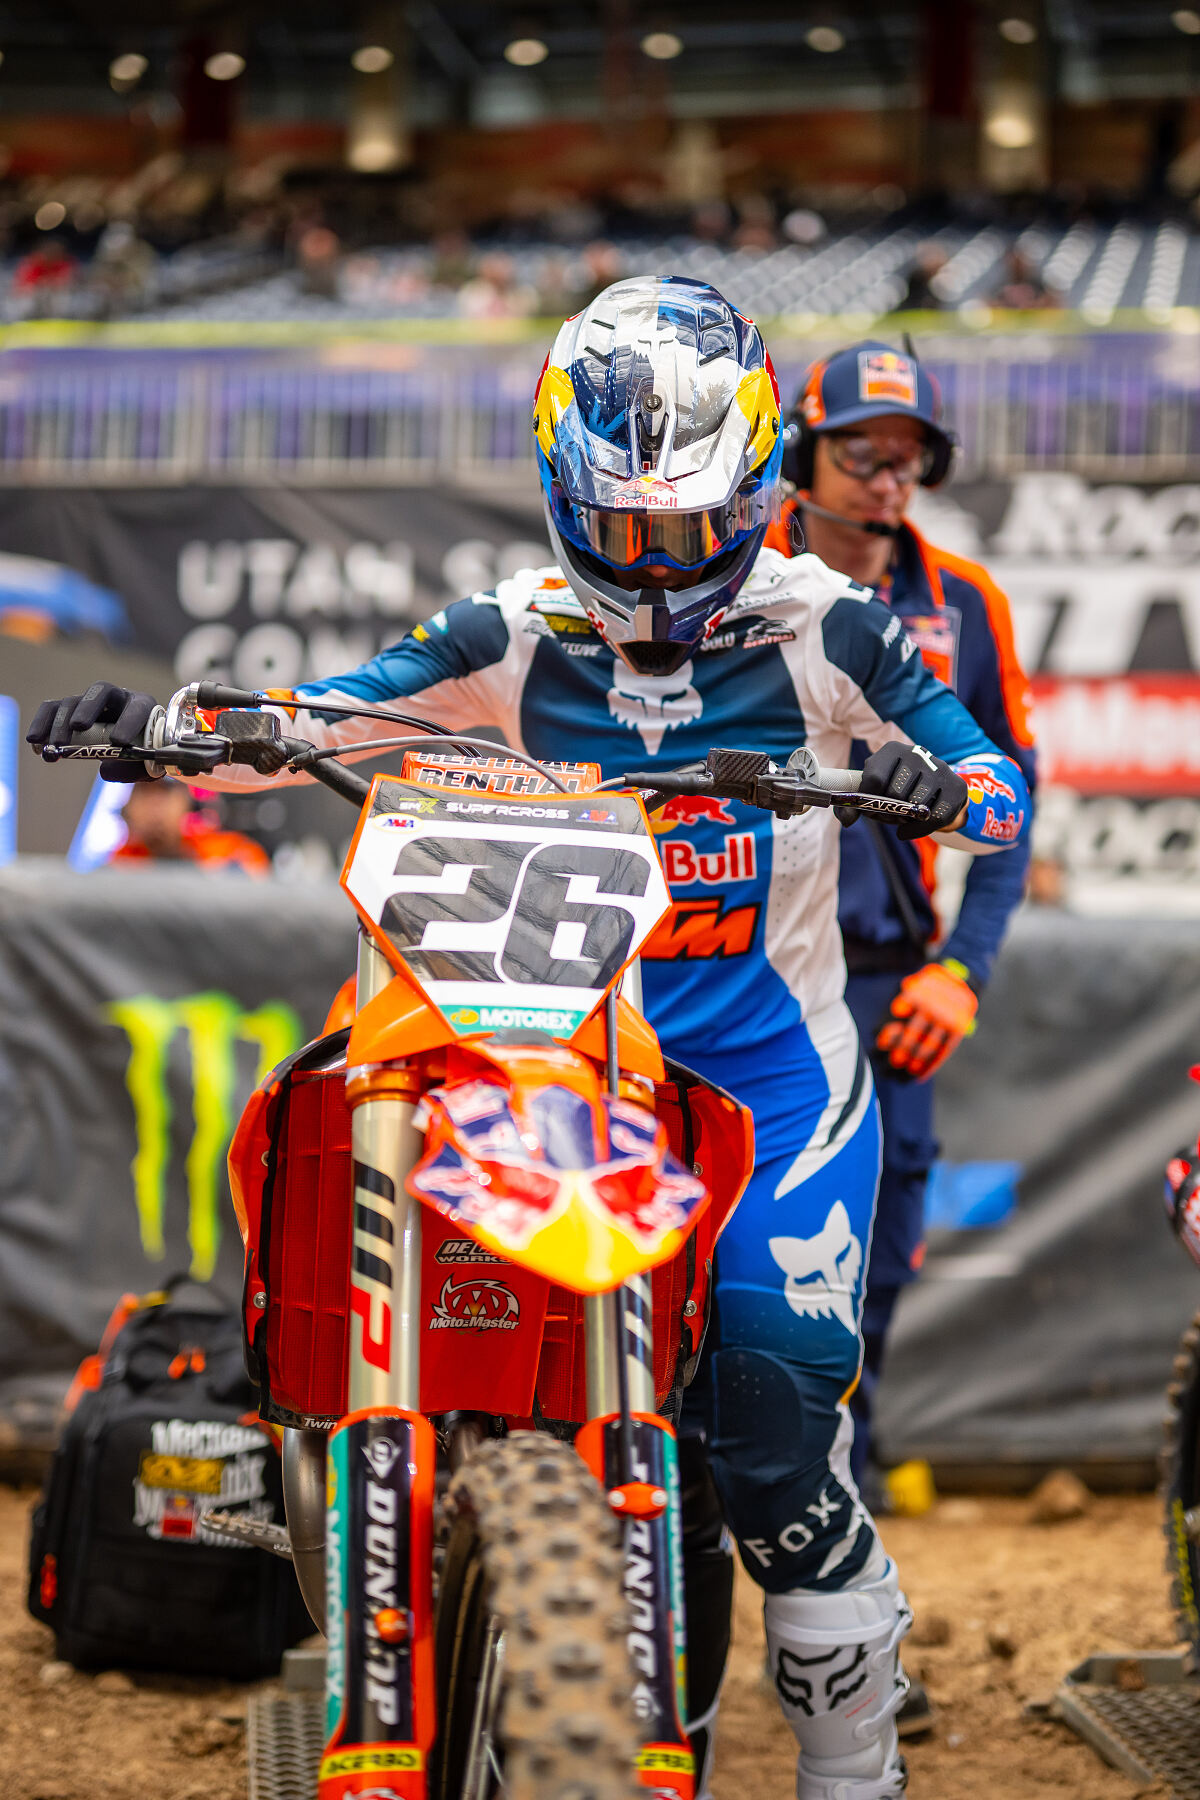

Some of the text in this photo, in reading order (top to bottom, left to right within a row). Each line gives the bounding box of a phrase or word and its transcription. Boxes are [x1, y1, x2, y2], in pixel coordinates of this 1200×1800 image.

[615, 494, 678, 508] Red Bull
[69, 747, 122, 759] ARC
[417, 767, 584, 794] RENTHAL
[859, 799, 912, 815] ARC
[662, 834, 756, 884] Bull
[379, 836, 652, 989] 26
[480, 1008, 574, 1031] MOTOREX
[742, 1487, 842, 1568] FOX
